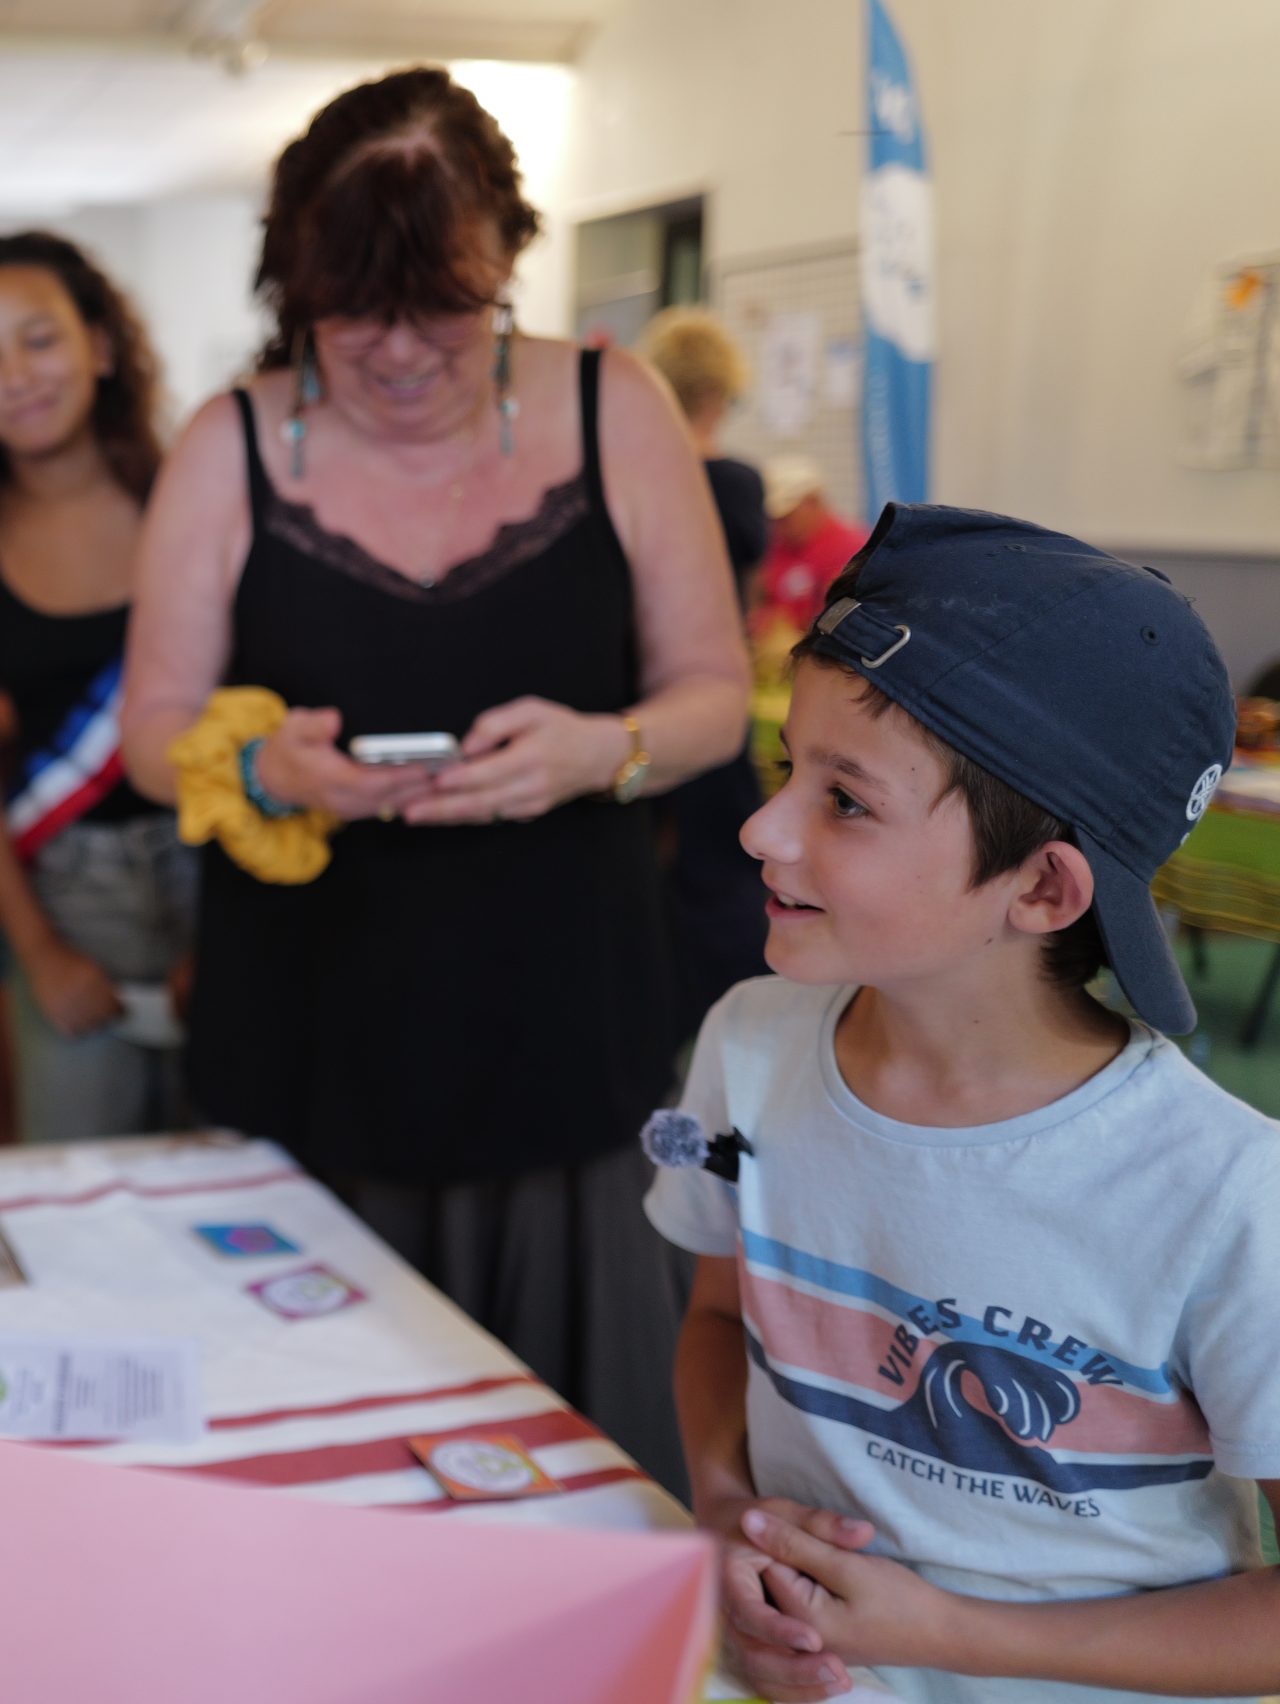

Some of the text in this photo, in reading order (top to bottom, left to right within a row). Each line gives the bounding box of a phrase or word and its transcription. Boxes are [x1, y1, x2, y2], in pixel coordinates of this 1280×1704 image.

[877, 1298, 1123, 1387] VIBES CREW
[867, 1440, 1101, 1518] CATCH THE WAVES
